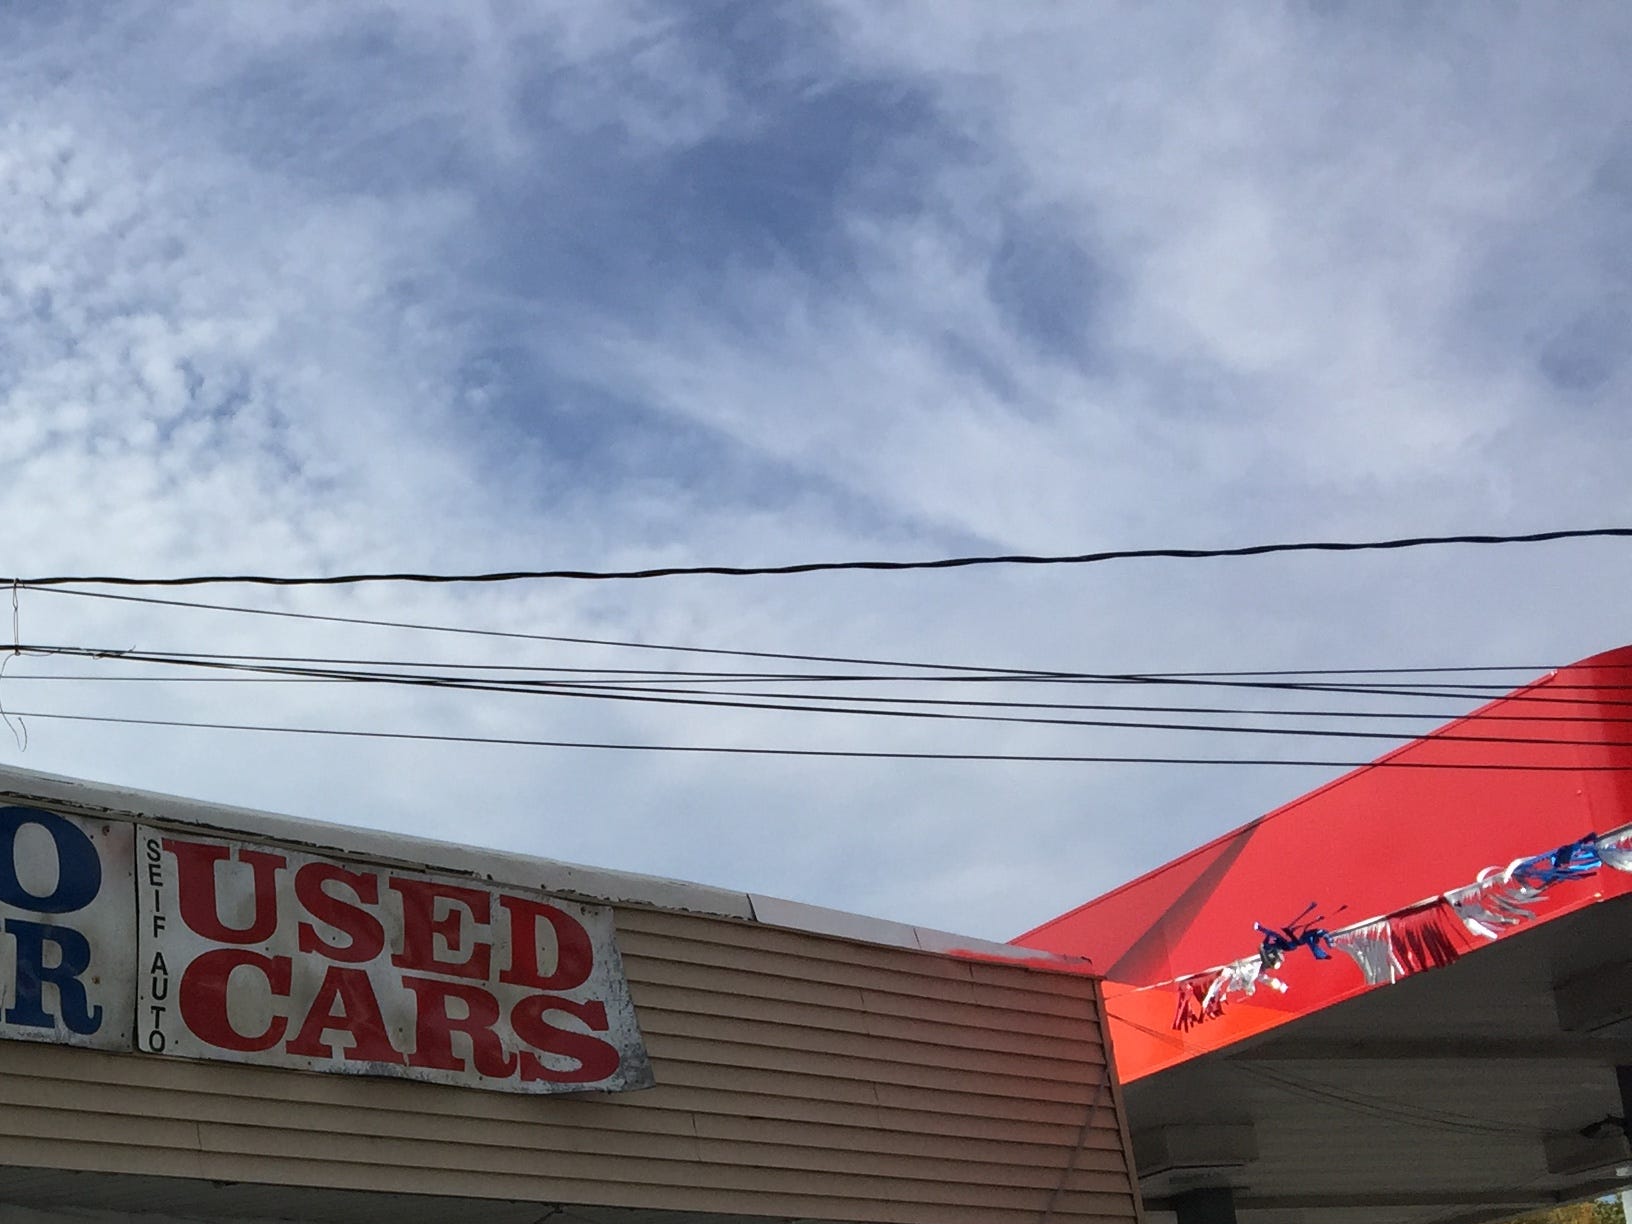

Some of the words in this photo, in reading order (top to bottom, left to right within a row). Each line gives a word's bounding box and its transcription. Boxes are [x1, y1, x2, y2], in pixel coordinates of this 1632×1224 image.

[162, 838, 594, 991] USED
[149, 951, 168, 1053] AUTO
[179, 949, 620, 1084] CARS
